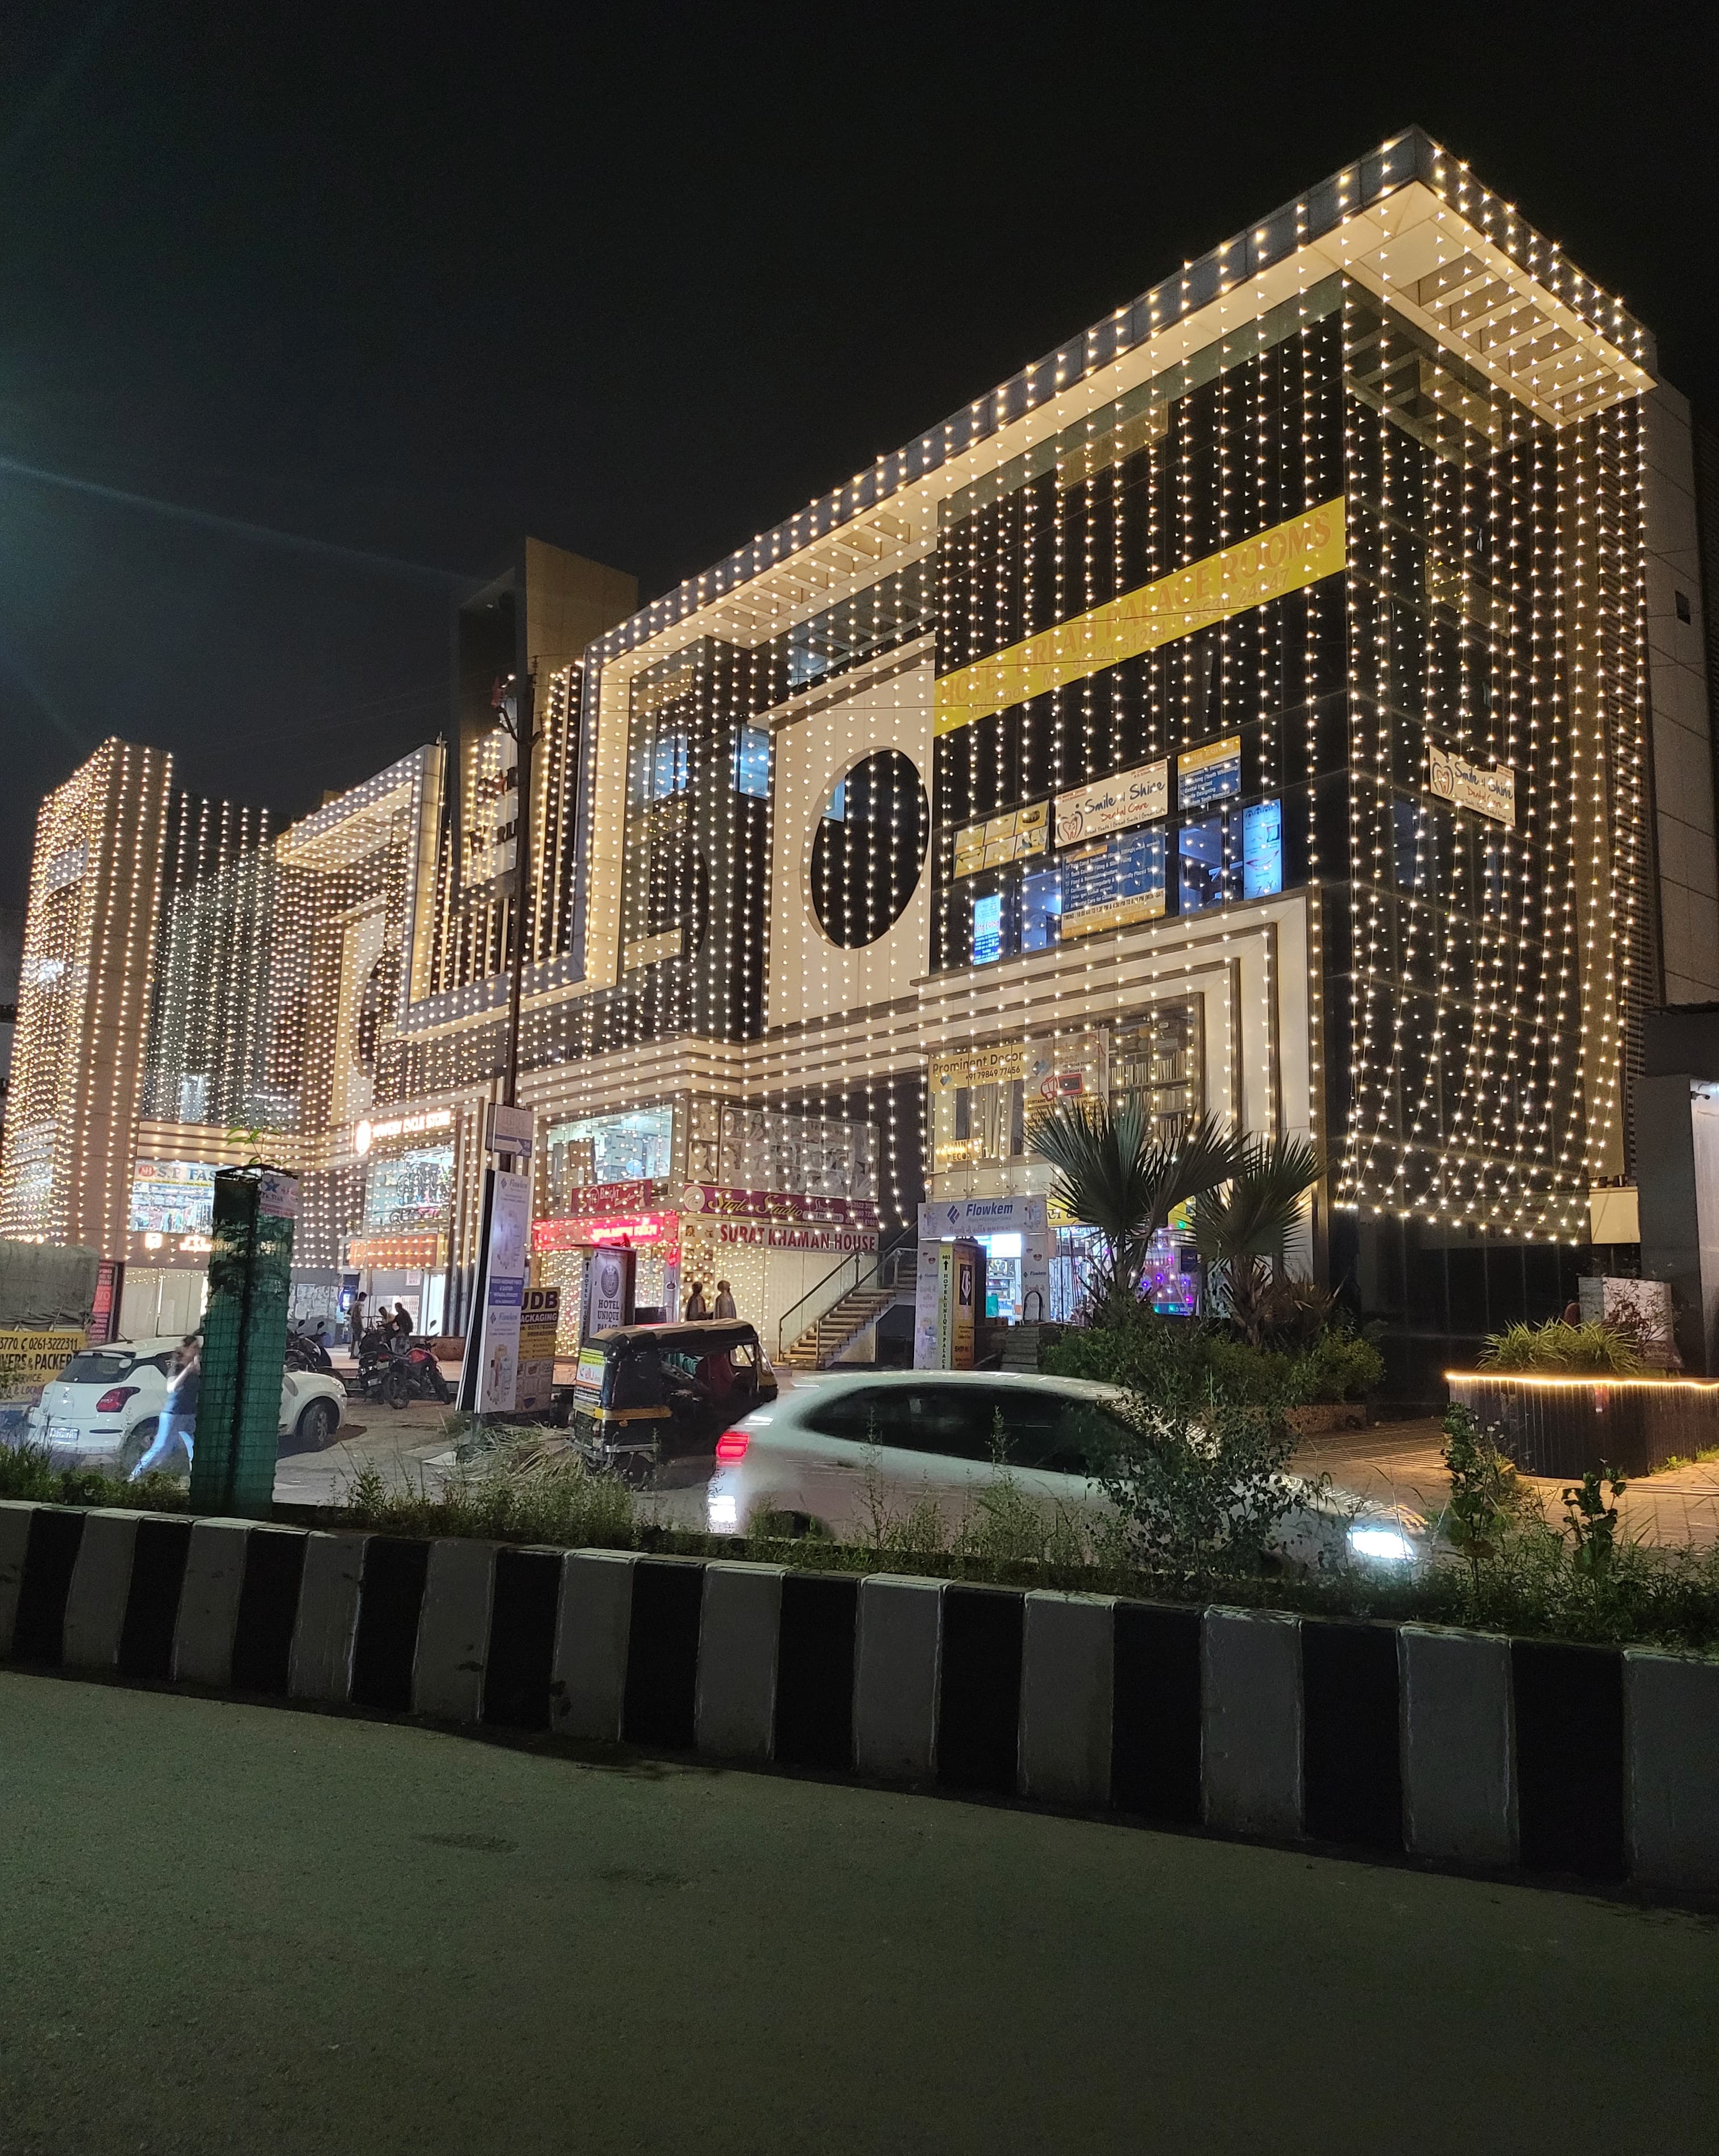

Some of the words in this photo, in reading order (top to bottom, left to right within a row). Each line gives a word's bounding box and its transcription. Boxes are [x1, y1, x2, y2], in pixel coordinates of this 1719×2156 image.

[941, 658, 1007, 706] HOTEL
[1016, 616, 1097, 677] DREAM
[1106, 563, 1210, 637] PALACE
[1220, 511, 1331, 588] ROOMS
[1454, 761, 1479, 785] Smile
[1085, 791, 1117, 814] Smile
[1128, 802, 1149, 813] Care
[933, 1055, 987, 1075] Prominent
[990, 1051, 1024, 1065] Decor
[948, 1152, 972, 1161] ECOR
[707, 1190, 748, 1213] Style
[755, 1195, 803, 1217] Studio
[966, 1202, 1013, 1216] Flowkem
[720, 1224, 765, 1245] SURAT
[768, 1229, 830, 1249] KHAMAN
[834, 1233, 875, 1250] HOUSE
[598, 1299, 619, 1309] HOTEL
[521, 1313, 557, 1323] ACKAGING
[597, 1311, 619, 1322] UNIQUE
